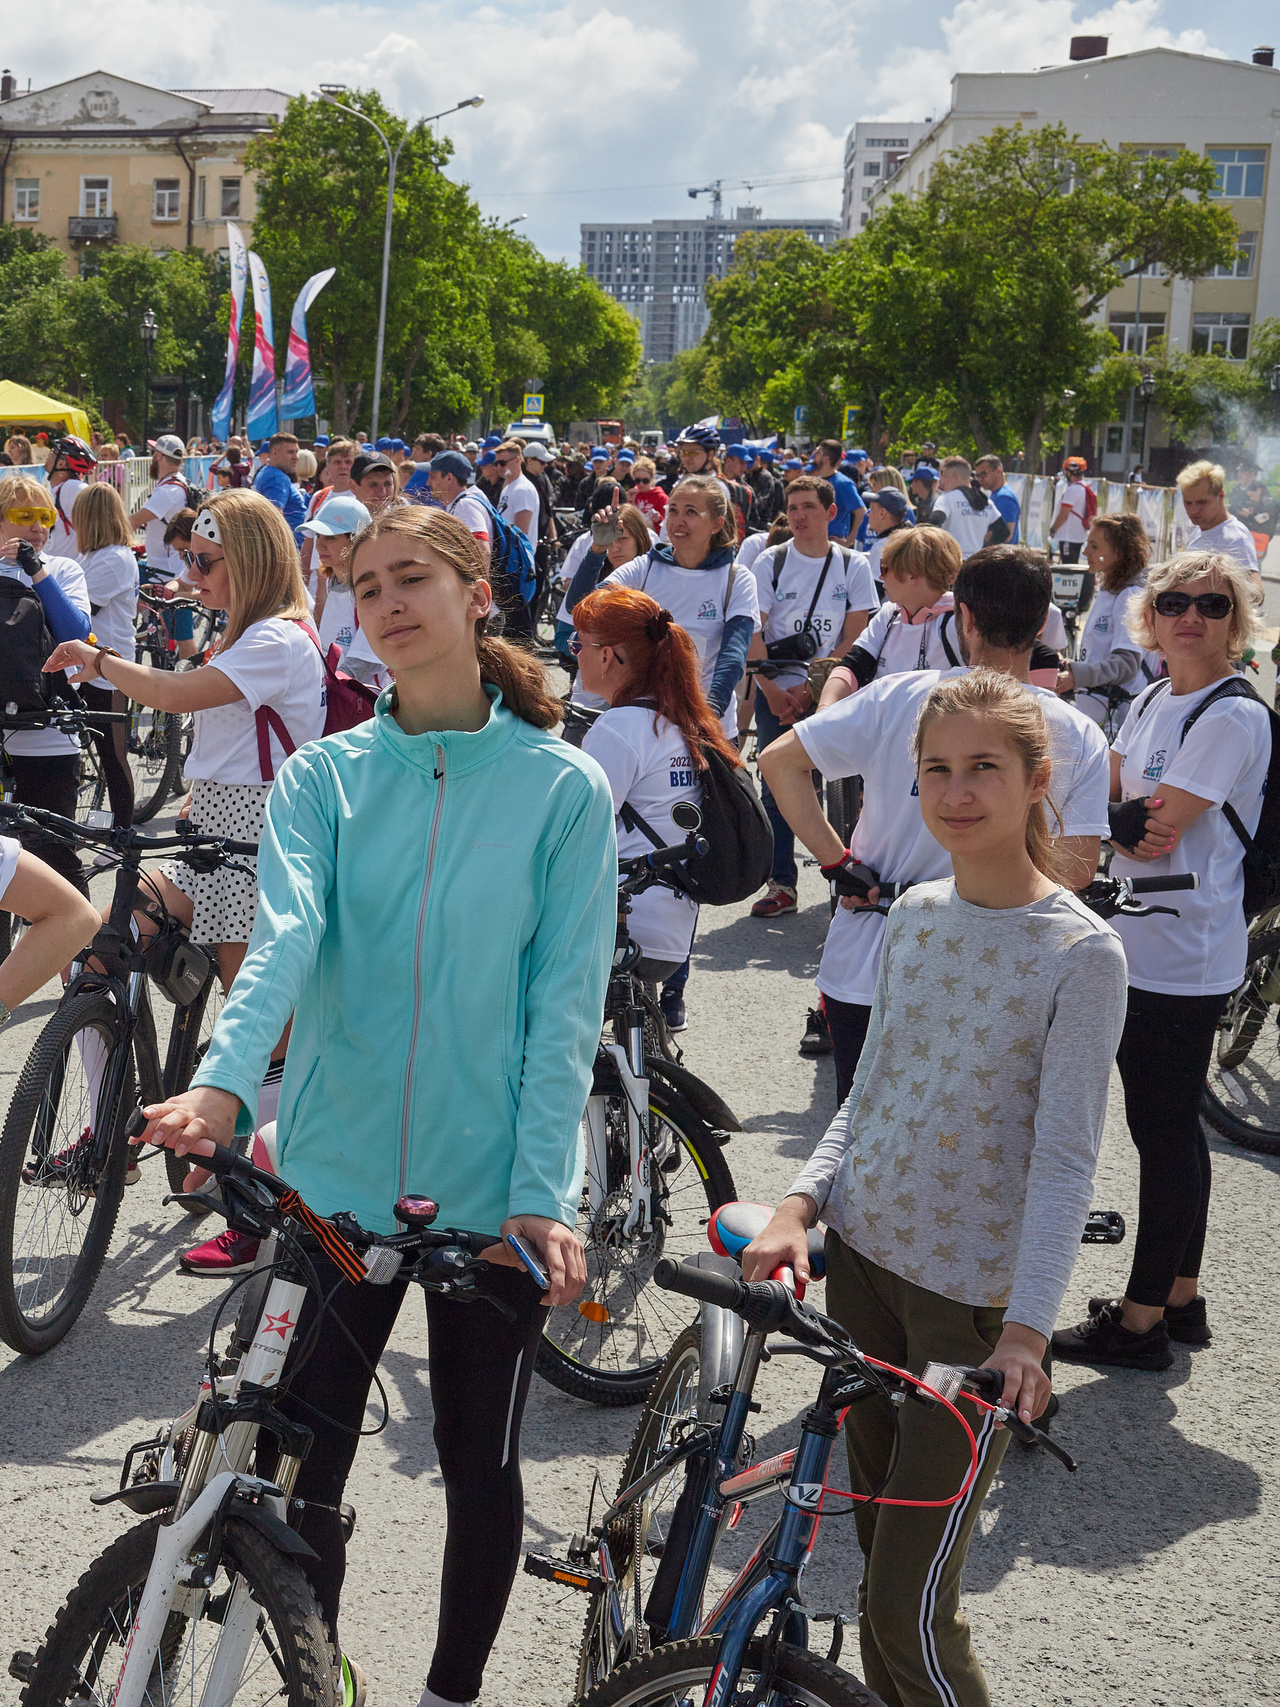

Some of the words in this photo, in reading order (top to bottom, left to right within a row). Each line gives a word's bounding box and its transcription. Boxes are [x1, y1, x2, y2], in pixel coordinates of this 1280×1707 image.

[1062, 579, 1078, 587] ВТБ
[794, 619, 832, 633] 035
[670, 756, 691, 767] 2022
[561, 1359, 597, 1382] KENDA
